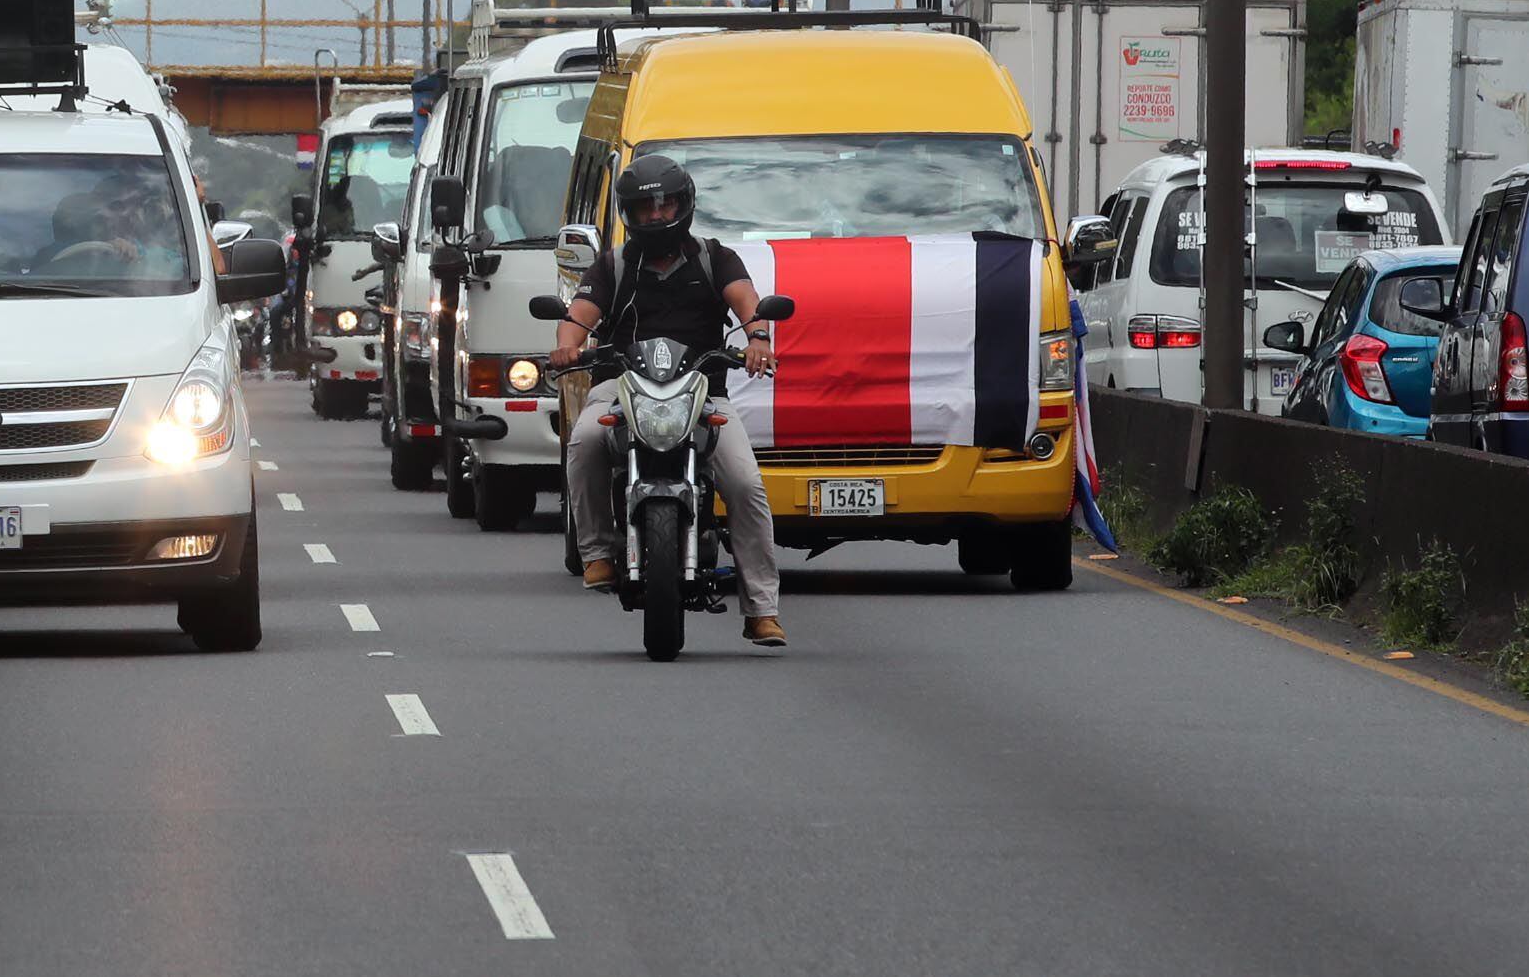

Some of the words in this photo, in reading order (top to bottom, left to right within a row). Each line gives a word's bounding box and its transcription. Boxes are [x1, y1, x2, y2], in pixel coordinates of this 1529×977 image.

[1127, 94, 1171, 104] CONDUZCO
[1178, 212, 1192, 227] SE
[1367, 214, 1382, 225] SE
[1382, 211, 1417, 227] VENDE
[1335, 235, 1353, 246] SE
[829, 488, 876, 507] 15425
